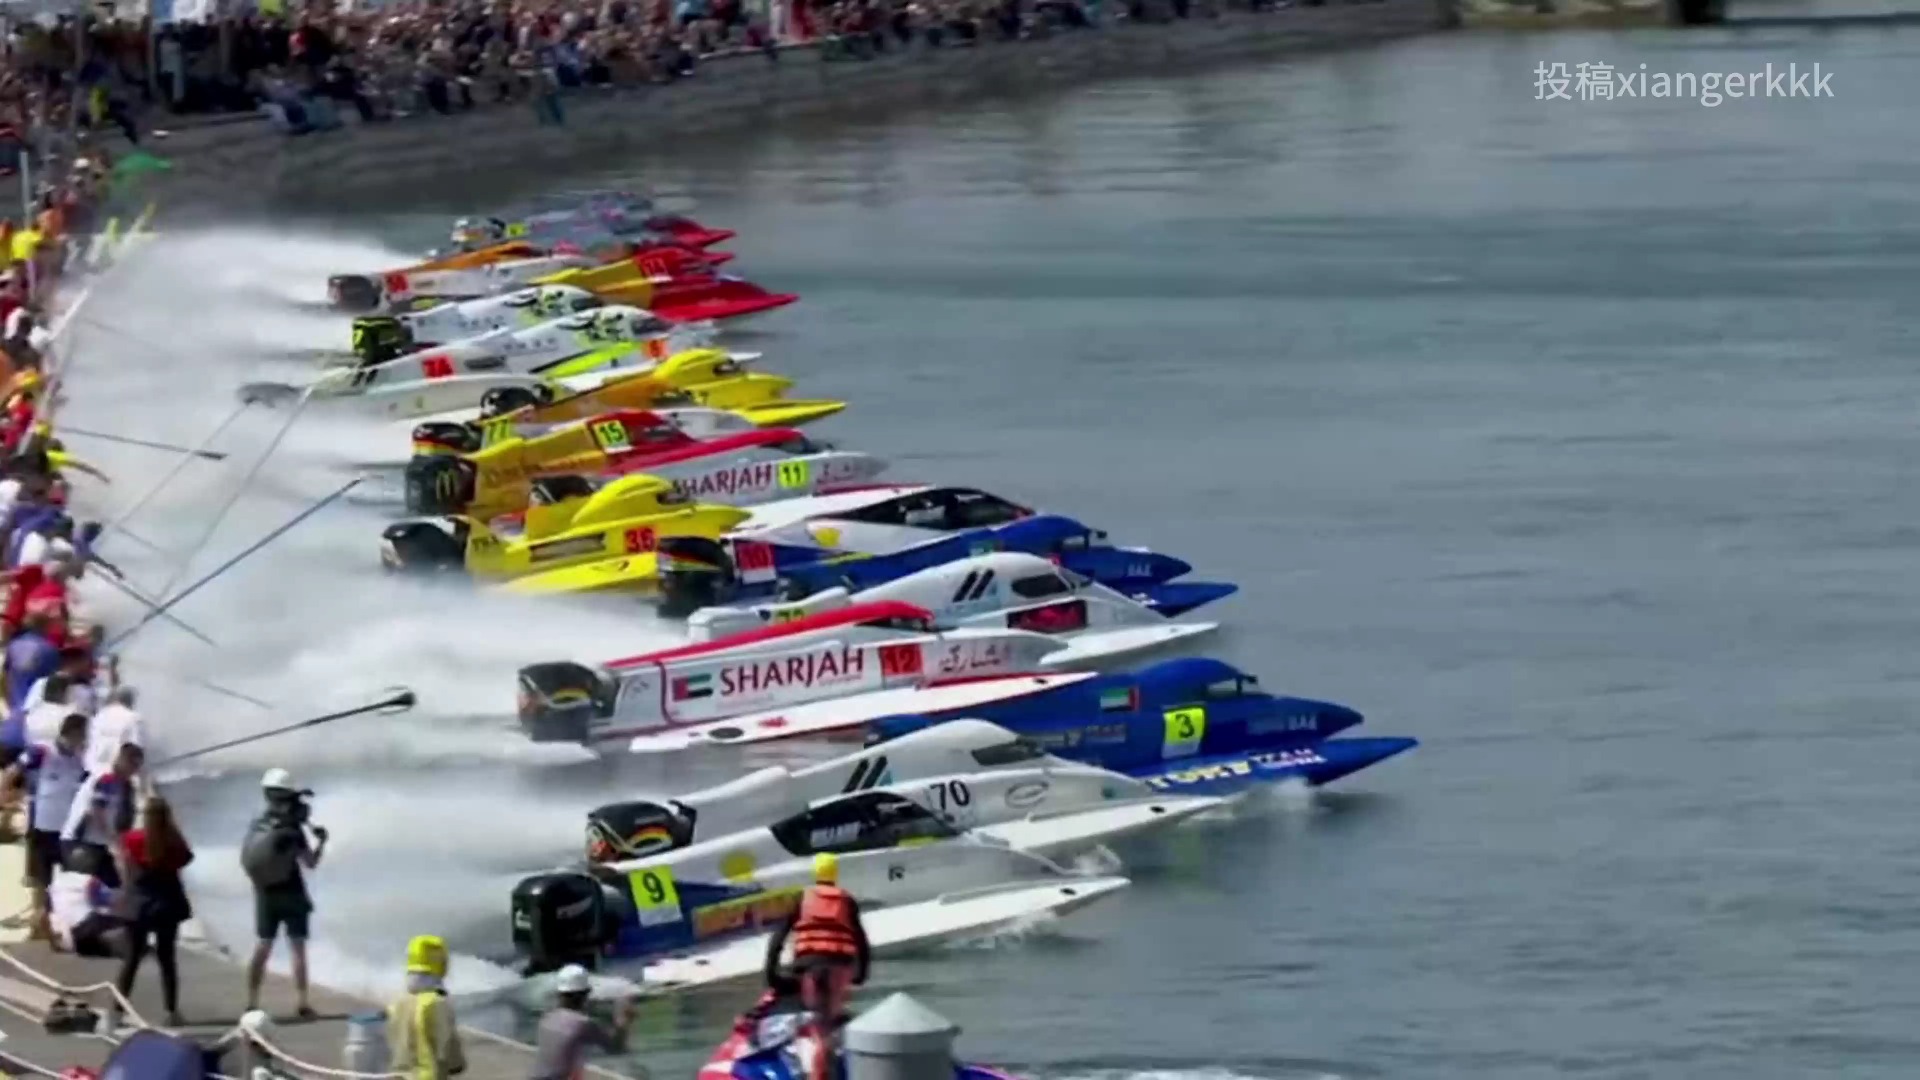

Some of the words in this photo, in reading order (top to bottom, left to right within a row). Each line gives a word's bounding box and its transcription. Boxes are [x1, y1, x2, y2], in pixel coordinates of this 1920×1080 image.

[599, 420, 625, 445] 15
[781, 462, 802, 483] 11
[719, 646, 865, 698] SHARJAH
[885, 647, 917, 675] 12
[1173, 712, 1196, 739] 3
[929, 779, 971, 811] 70
[642, 870, 667, 904] 9
